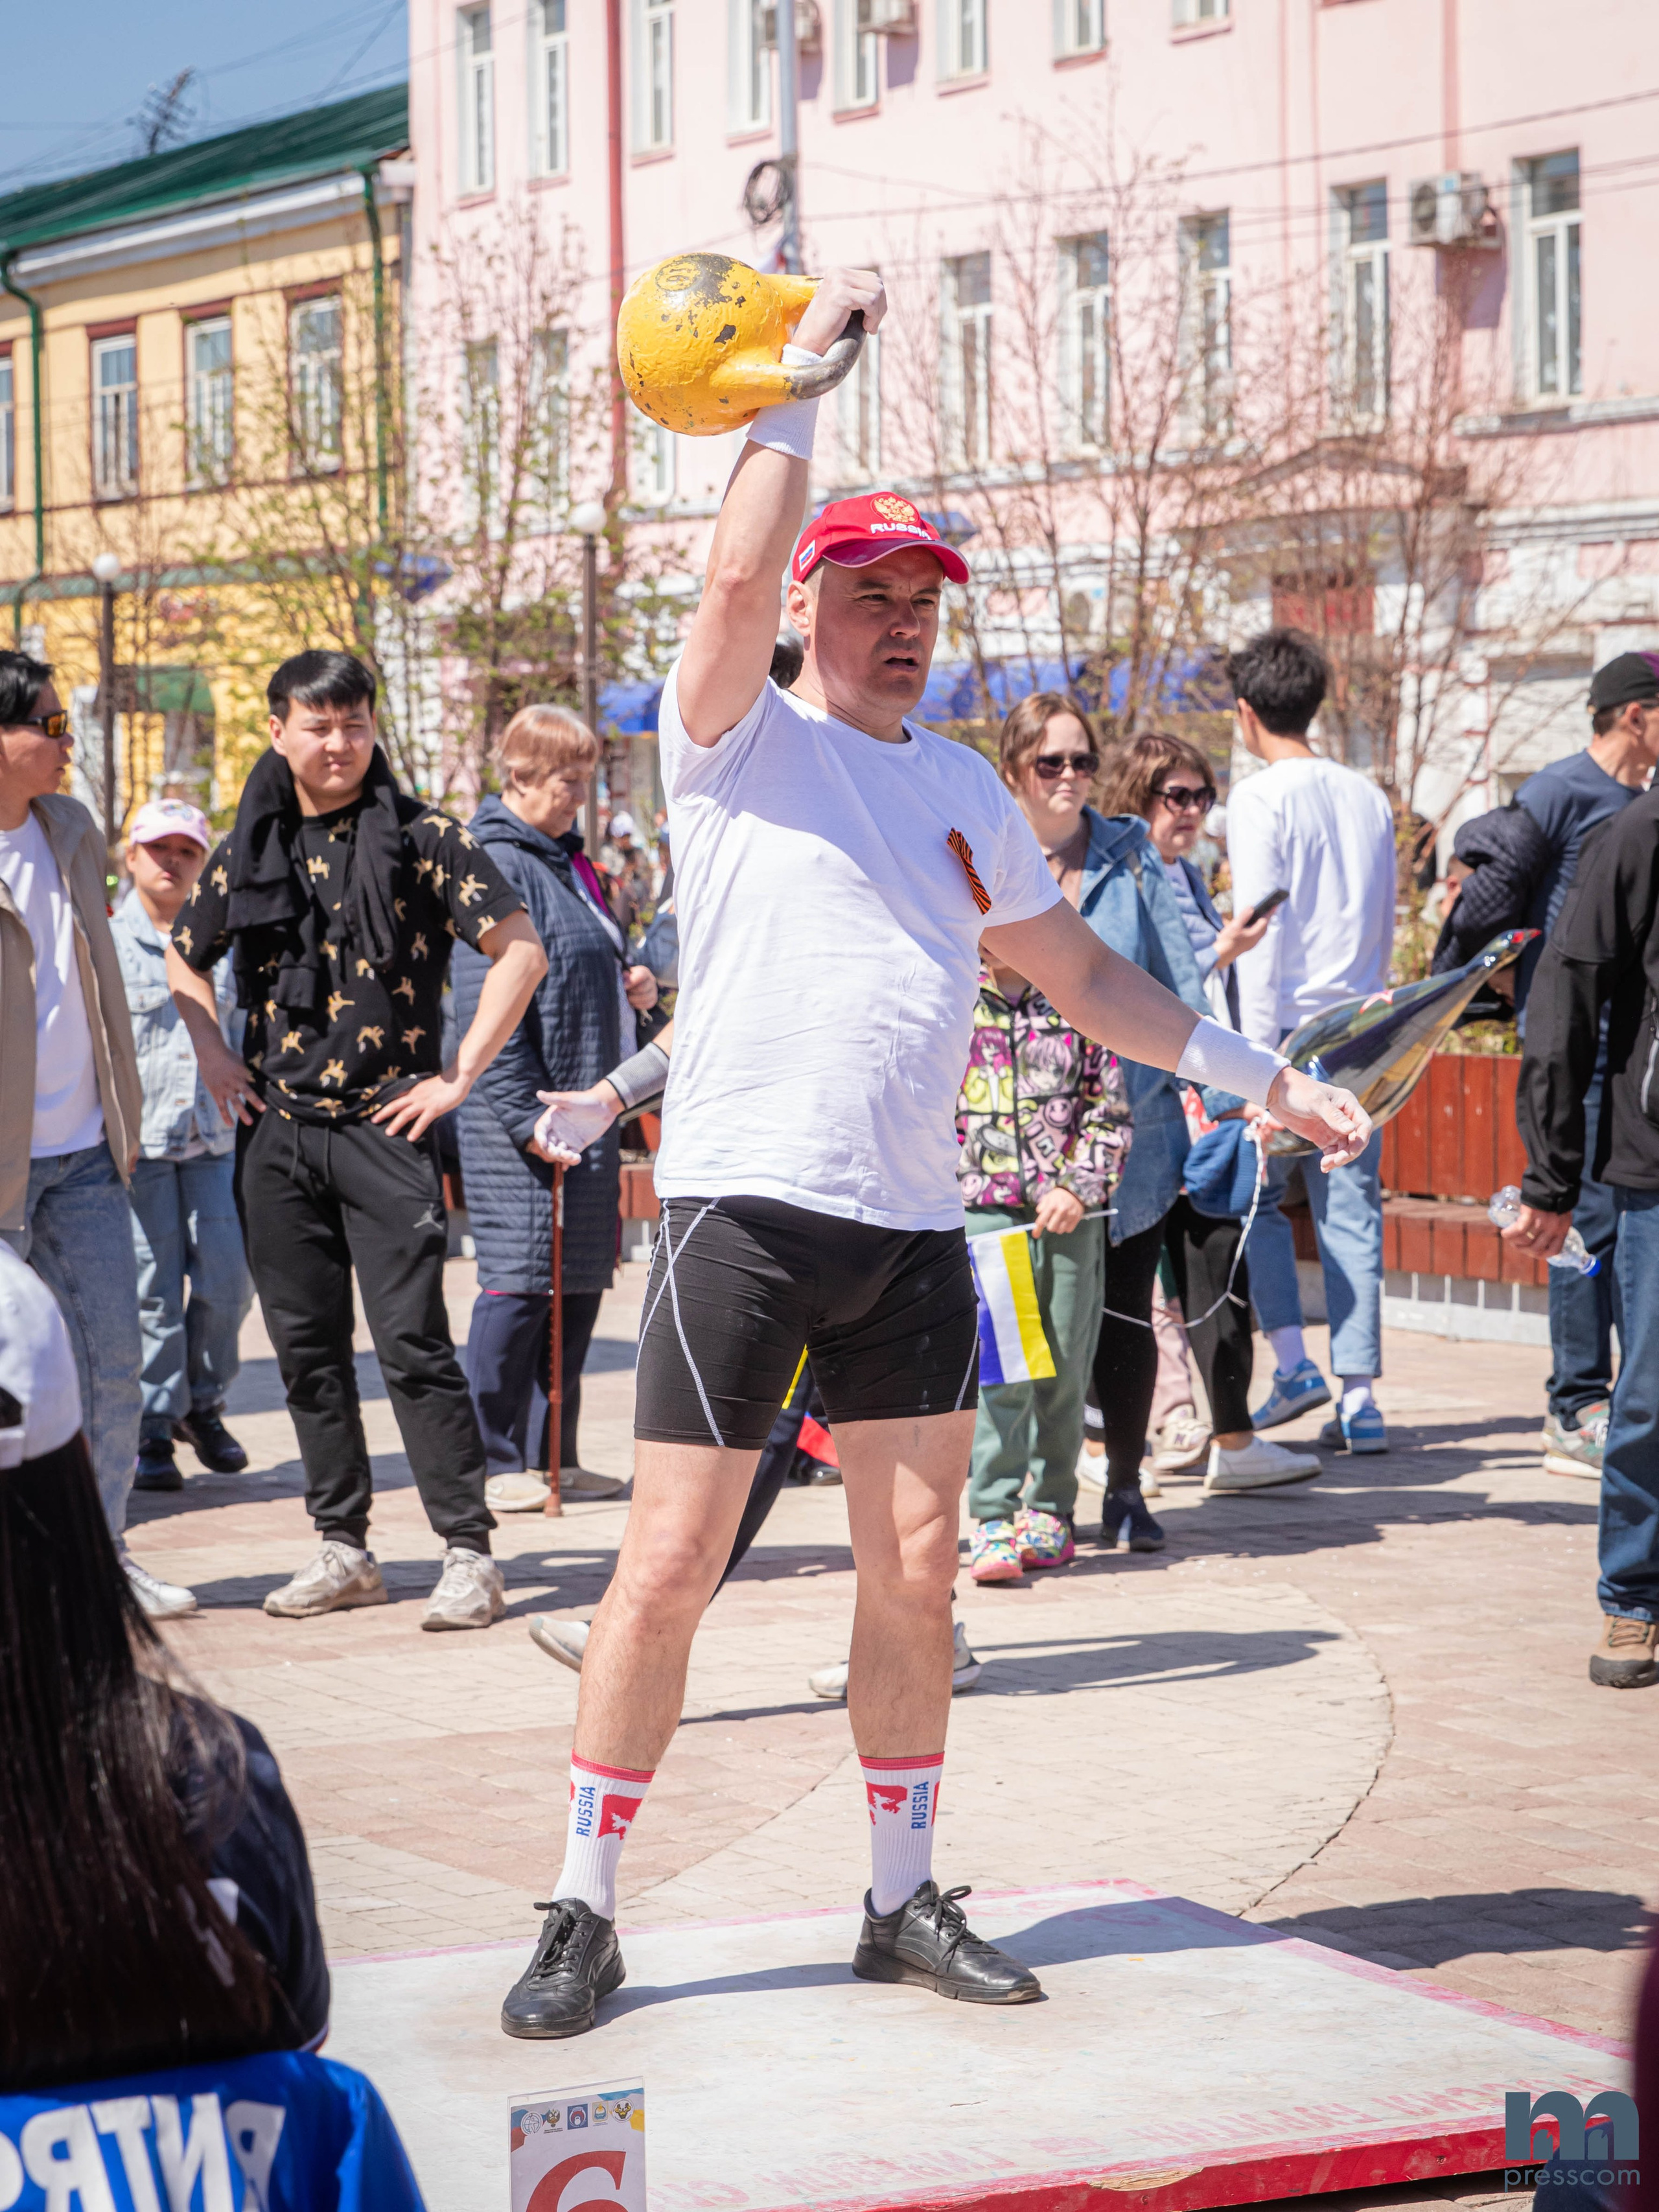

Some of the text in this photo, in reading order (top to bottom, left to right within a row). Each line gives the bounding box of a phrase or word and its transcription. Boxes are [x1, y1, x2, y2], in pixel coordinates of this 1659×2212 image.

[870, 522, 933, 541] RUSSIA
[576, 1786, 596, 1837] RUSSIA
[911, 1781, 929, 1830] RUSSIA
